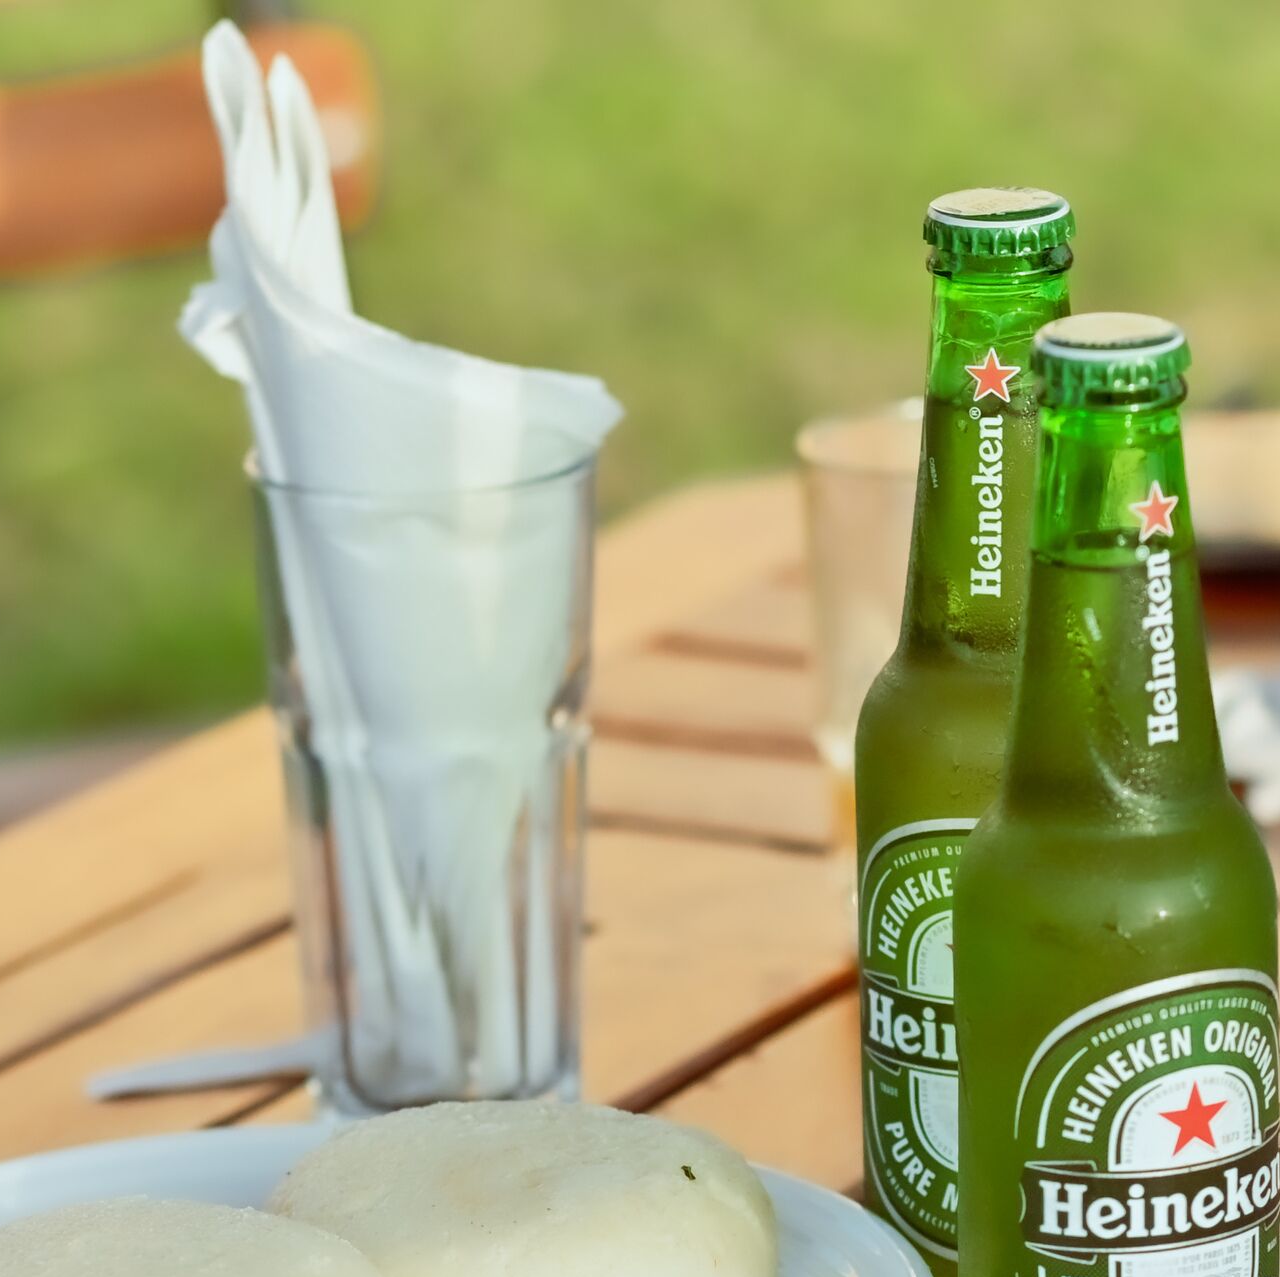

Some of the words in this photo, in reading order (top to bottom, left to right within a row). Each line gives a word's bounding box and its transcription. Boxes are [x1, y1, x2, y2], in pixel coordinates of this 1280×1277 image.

[970, 414, 1004, 598] Heineken
[1141, 548, 1179, 747] Heineken
[893, 846, 940, 869] PREMIUM
[946, 845, 962, 857] QU
[878, 867, 955, 960] HEINEKE
[1091, 1013, 1154, 1047] PREMIUM
[1160, 999, 1214, 1021] QUALITY
[1062, 1025, 1192, 1144] HEINEKEN
[1204, 1020, 1276, 1110] ORIGINAL
[884, 1121, 936, 1197] PURE
[918, 1207, 956, 1234] RECIPE
